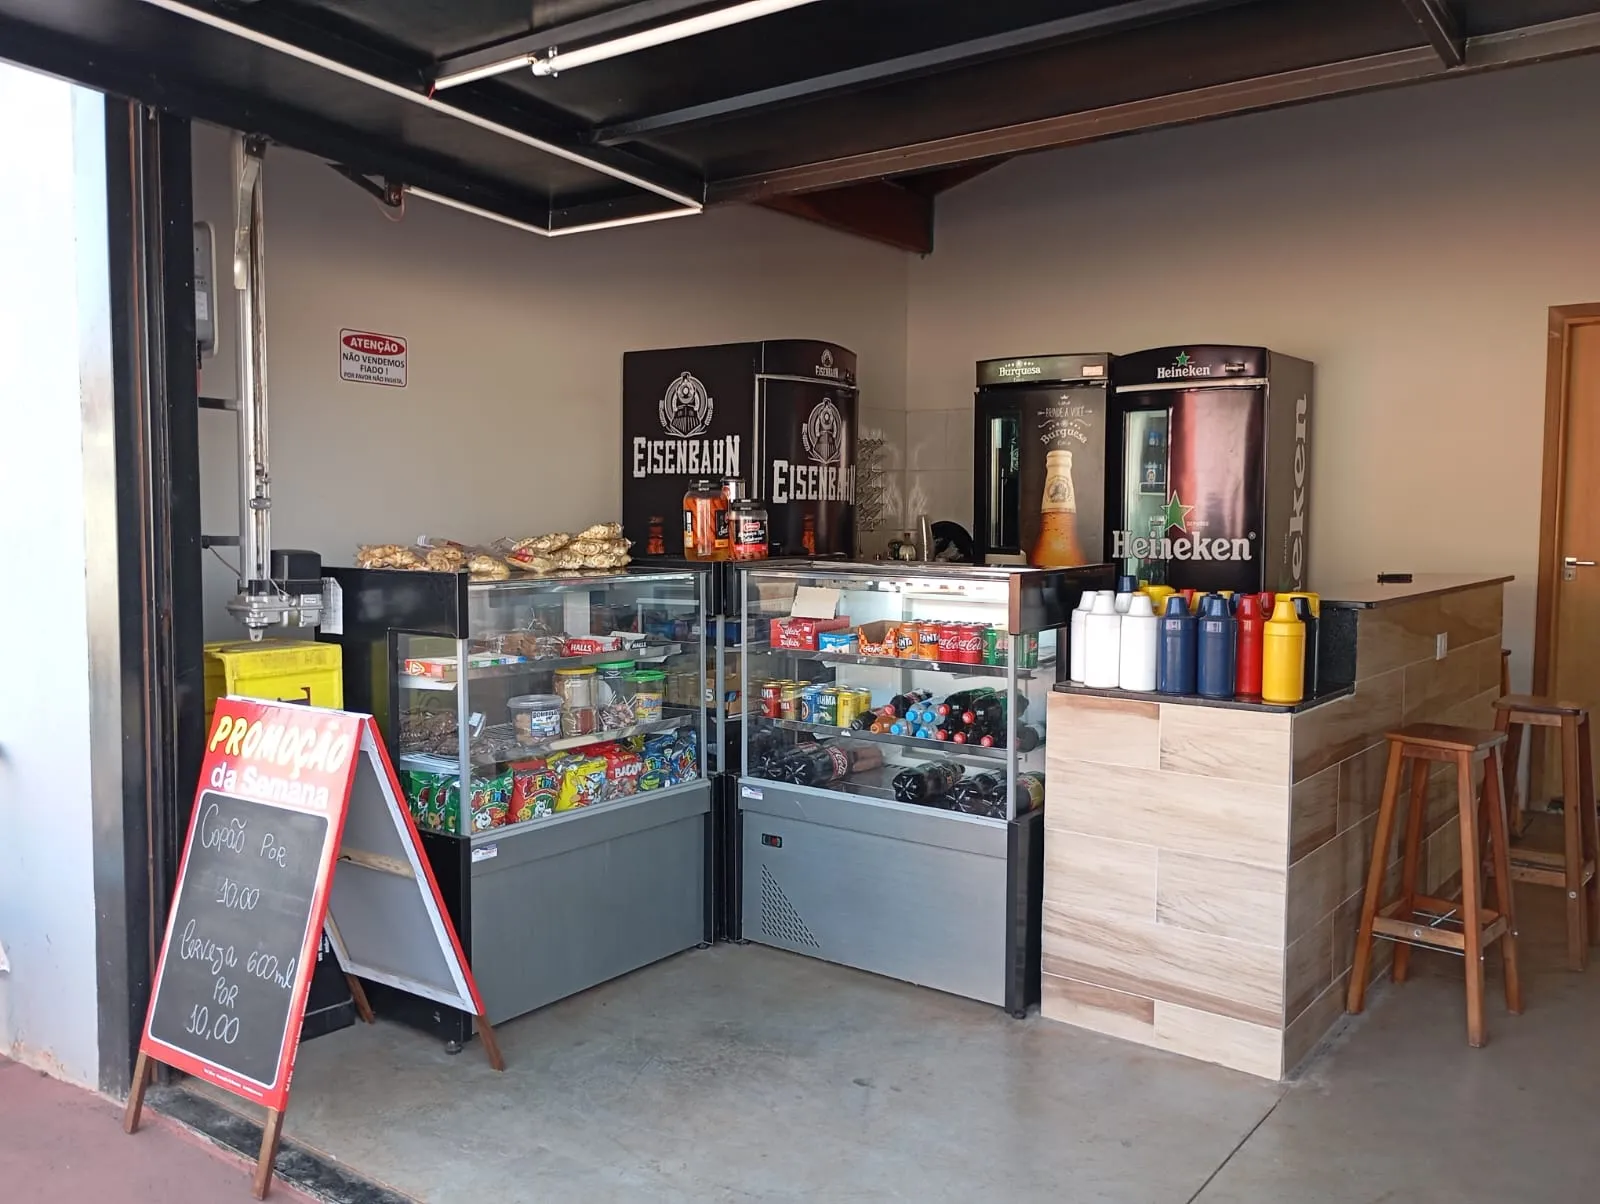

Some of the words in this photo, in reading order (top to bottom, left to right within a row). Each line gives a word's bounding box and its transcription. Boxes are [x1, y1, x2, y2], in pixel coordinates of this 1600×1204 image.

[350, 337, 398, 353] ATENÇÃO
[343, 352, 360, 361] NÃO
[362, 356, 404, 368] VENDEMOS
[360, 365, 383, 374] FIADO
[999, 366, 1041, 378] Burguesa
[1156, 365, 1211, 380] Heineken
[1040, 428, 1088, 445] Burguesa
[633, 435, 740, 478] EISENBAHN
[1112, 530, 1252, 561] Heineken
[570, 643, 593, 652] HALLS
[209, 715, 350, 779] PROMOÇÃO
[614, 761, 642, 779] BACON
[211, 761, 237, 793] da
[241, 766, 330, 810] Semana
[201, 803, 247, 854] Copão
[216, 878, 260, 910] 10,00
[185, 1004, 240, 1044] 10,00
